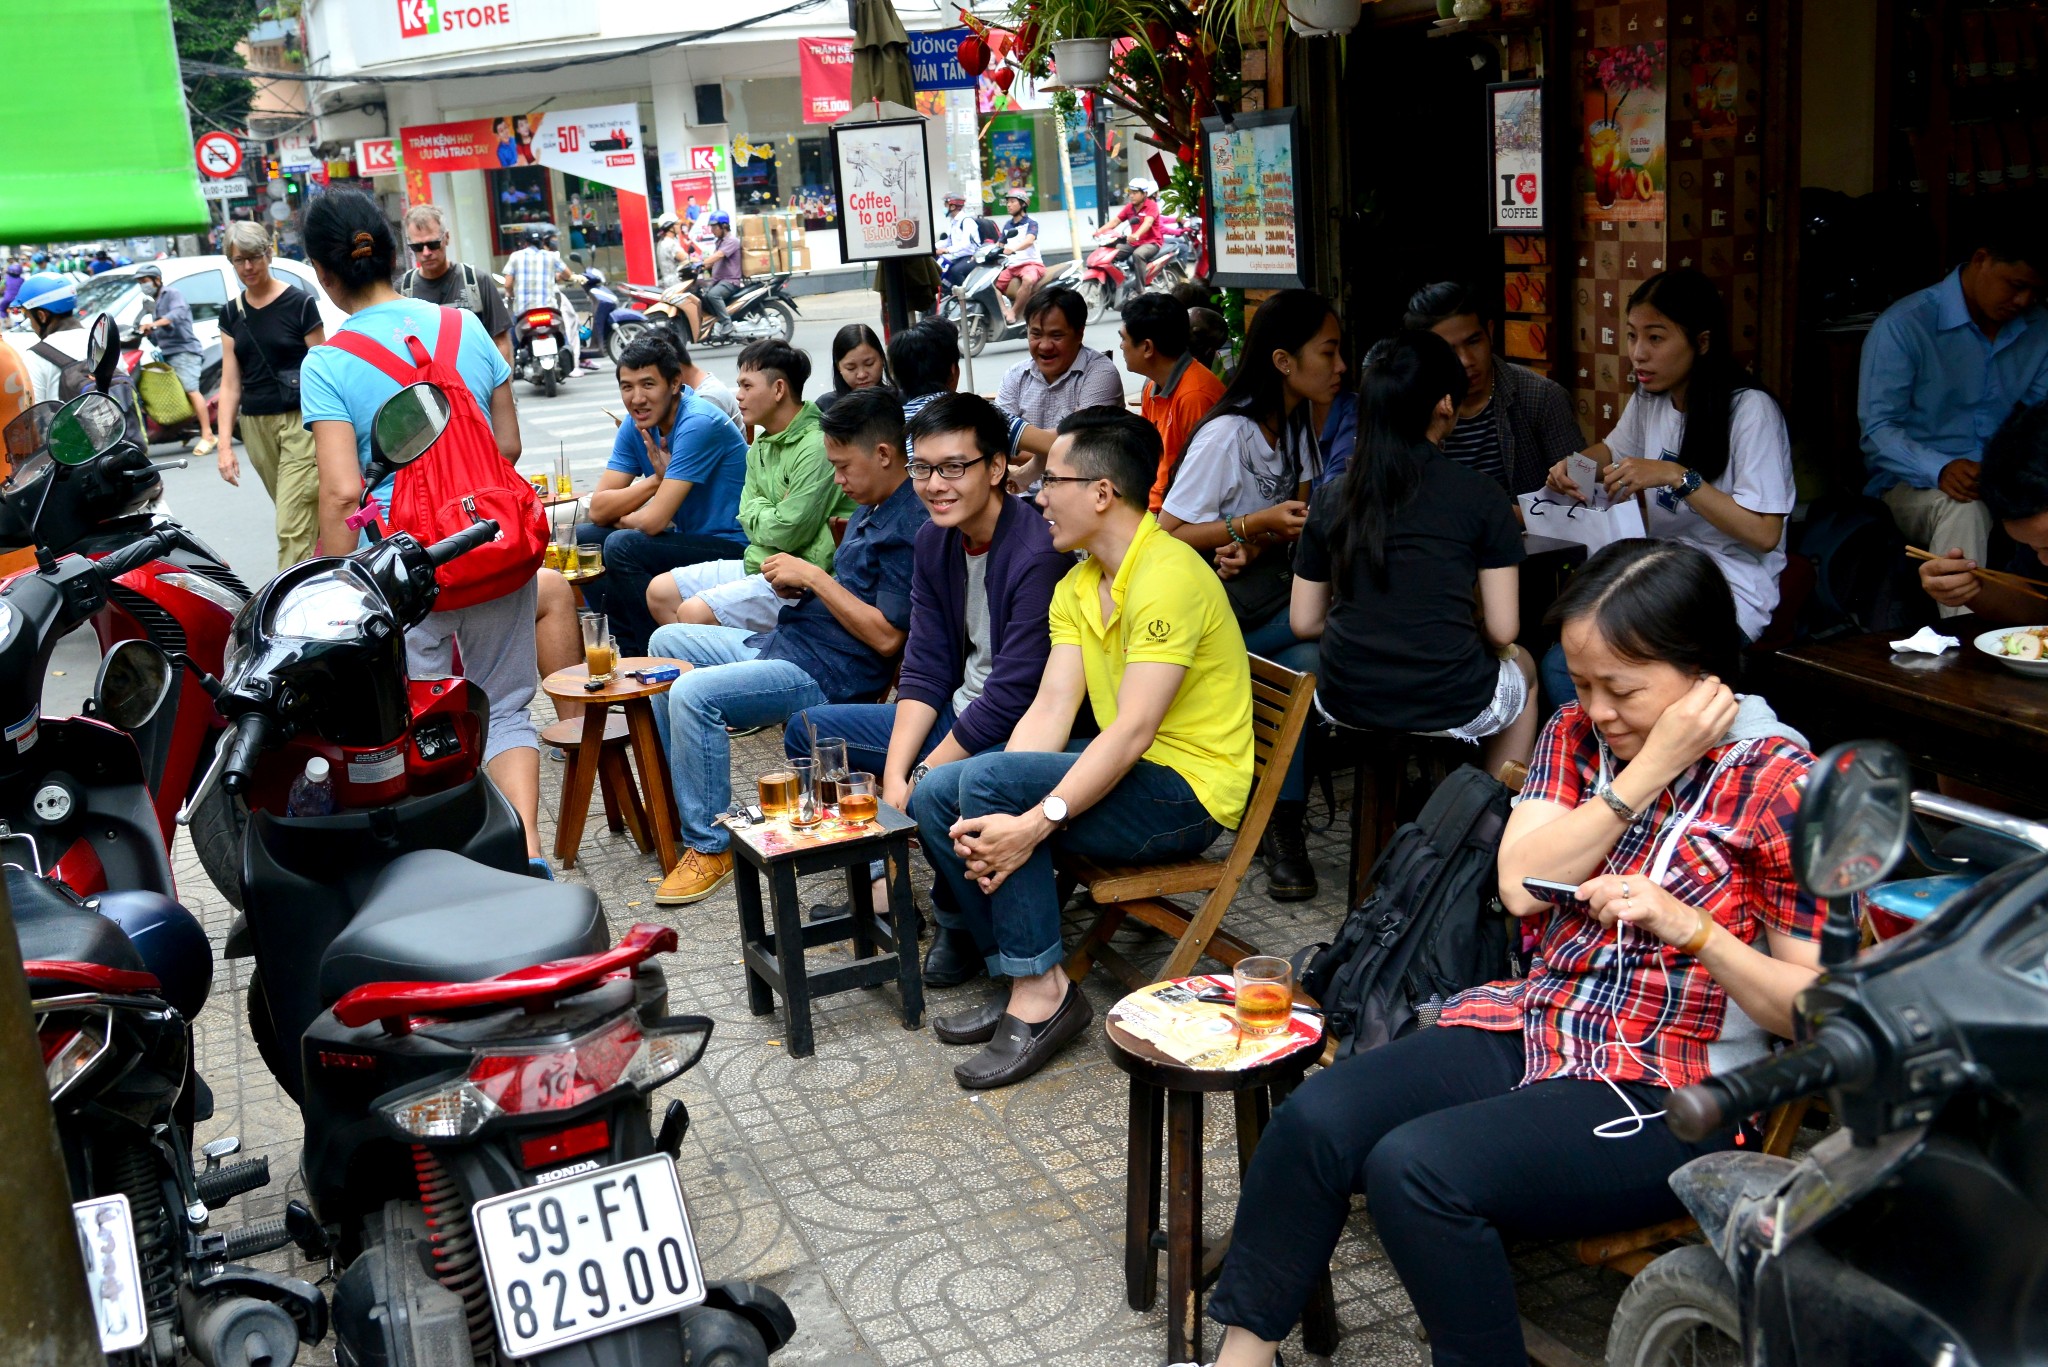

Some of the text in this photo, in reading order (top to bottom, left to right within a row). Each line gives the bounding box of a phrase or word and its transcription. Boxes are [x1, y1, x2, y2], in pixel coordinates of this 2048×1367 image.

[443, 3, 510, 31] STORE
[907, 37, 958, 56] ƯỜNG
[913, 60, 938, 83] VĂN
[812, 100, 850, 112] 125.000
[369, 145, 402, 165] K+
[693, 150, 723, 170] K+
[1501, 174, 1516, 206] I
[849, 191, 891, 210] Coffee
[859, 205, 897, 228] to go!
[1501, 207, 1538, 219] COFFEE
[863, 225, 898, 242] 15.000
[1225, 231, 1244, 241] Arabica
[1226, 245, 1245, 255] Arabica
[1155, 619, 1164, 632] R
[535, 1159, 601, 1185] HONDA
[506, 1173, 650, 1264] 59-F1
[506, 1236, 690, 1340] 829.00
